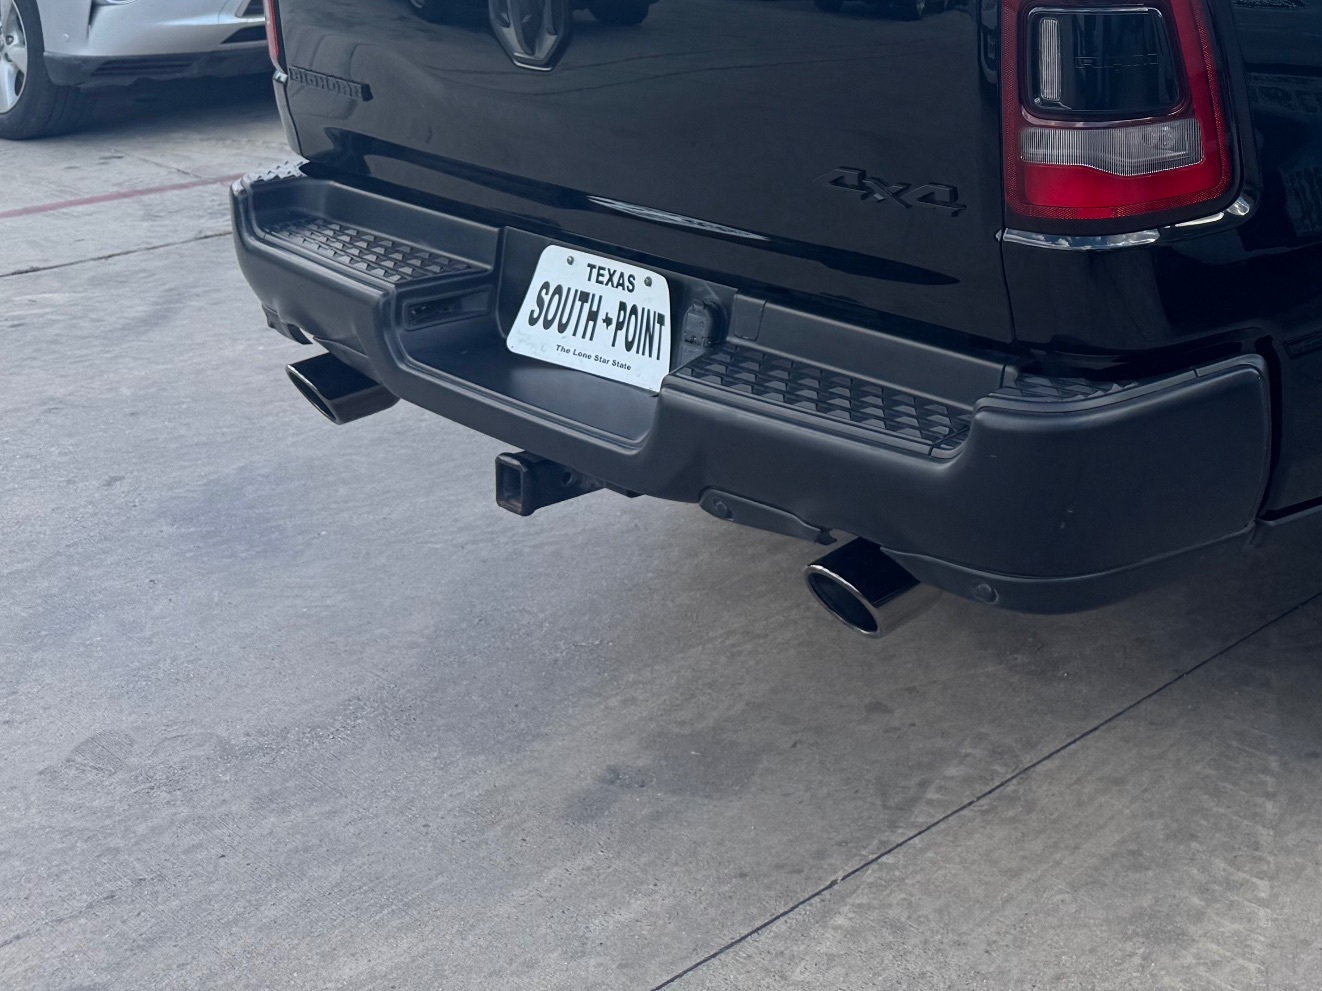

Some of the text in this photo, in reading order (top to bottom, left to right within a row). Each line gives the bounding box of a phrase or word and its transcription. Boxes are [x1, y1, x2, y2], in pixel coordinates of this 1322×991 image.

[586, 263, 636, 293] TEXAS
[528, 280, 666, 361] SOUTH POINT
[555, 344, 632, 371] The Lone Star State
